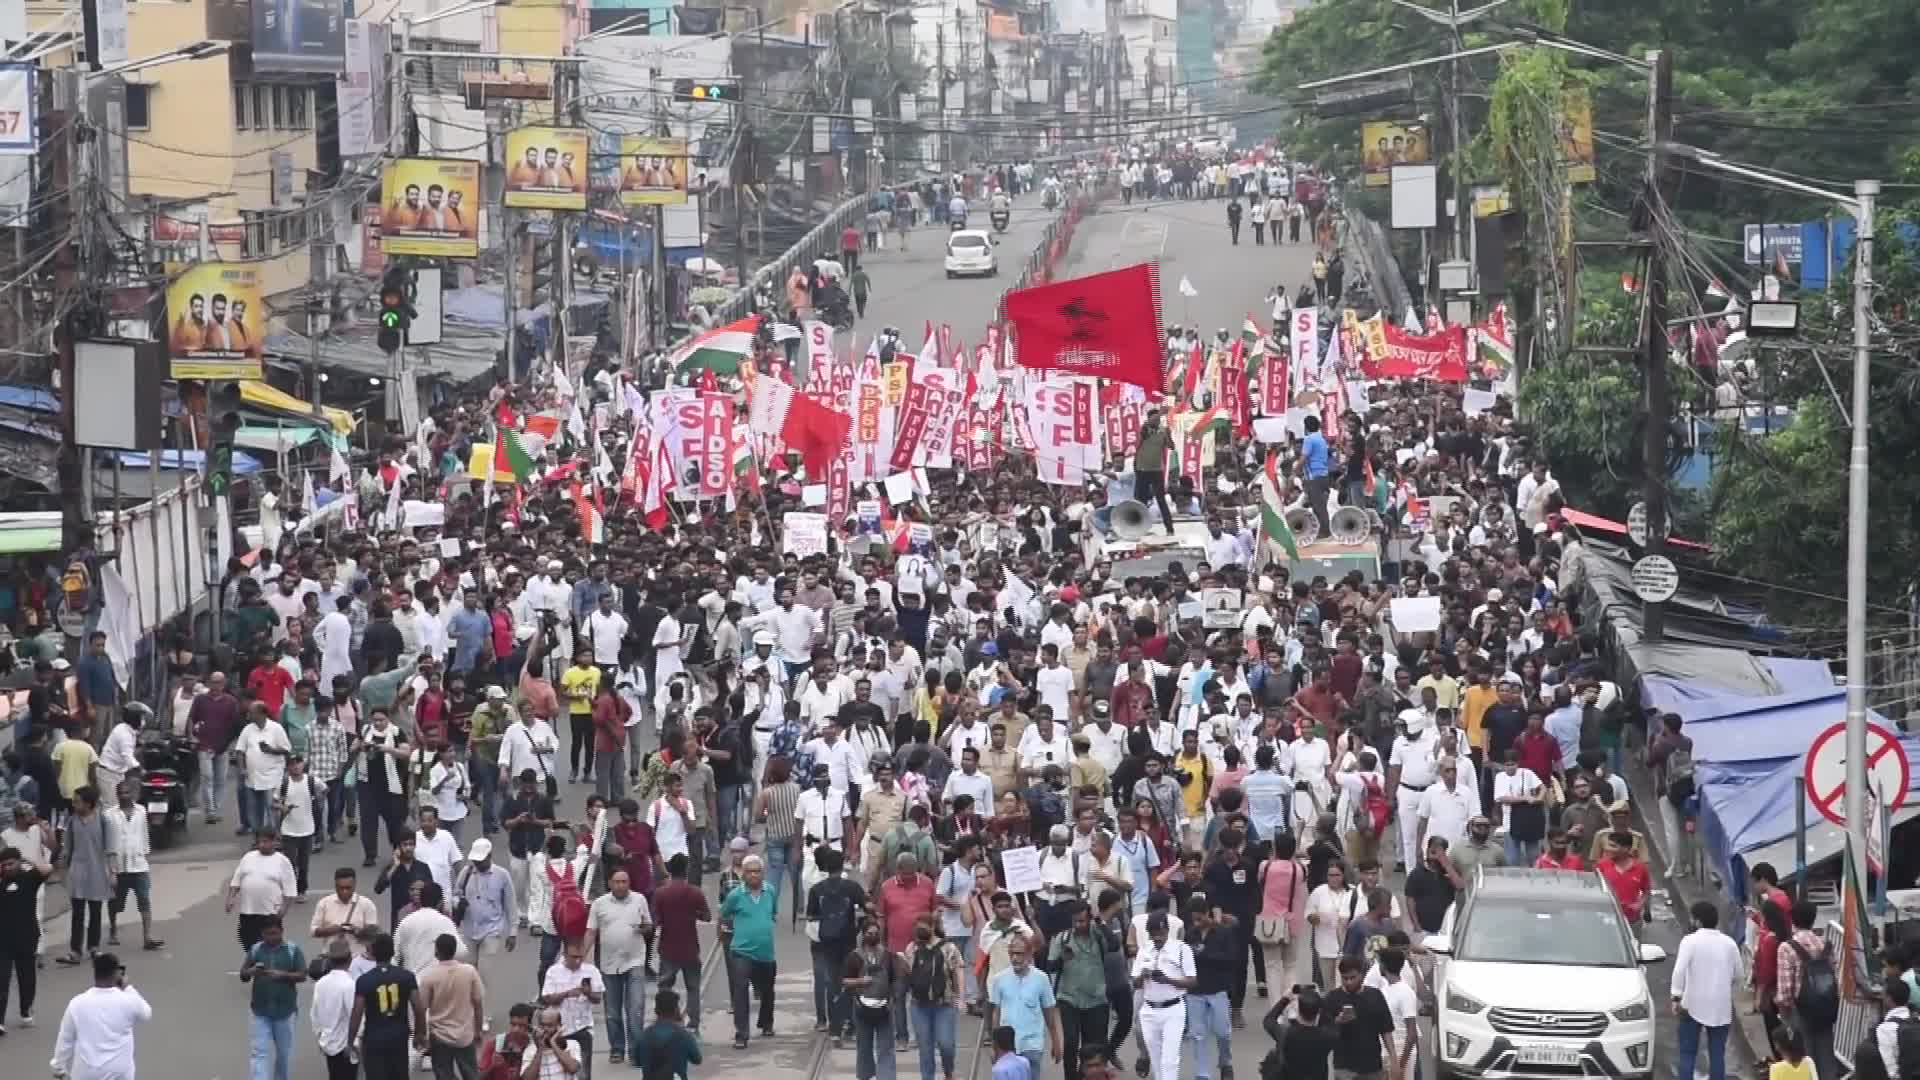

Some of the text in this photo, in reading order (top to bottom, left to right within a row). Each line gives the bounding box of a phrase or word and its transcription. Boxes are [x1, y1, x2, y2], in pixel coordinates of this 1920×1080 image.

[706, 400, 727, 488] AIDSO
[831, 460, 846, 514] AISA
[377, 983, 400, 1012] 11
